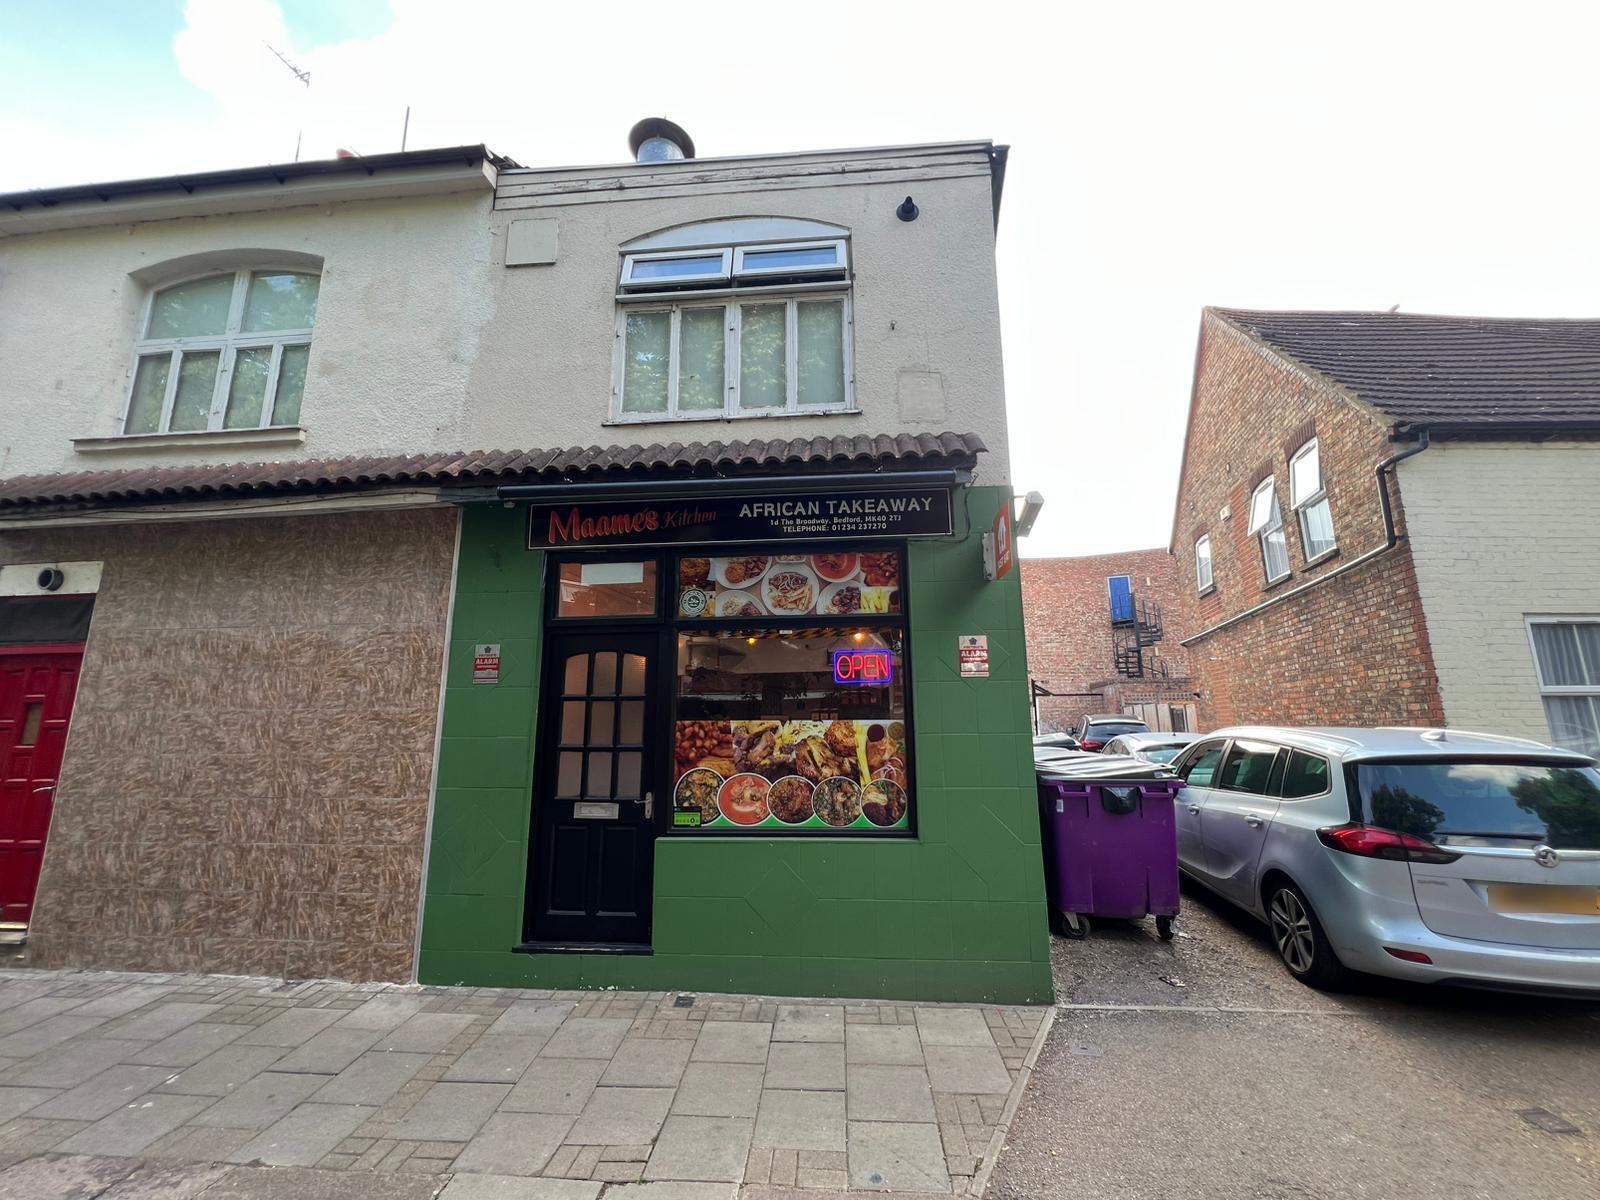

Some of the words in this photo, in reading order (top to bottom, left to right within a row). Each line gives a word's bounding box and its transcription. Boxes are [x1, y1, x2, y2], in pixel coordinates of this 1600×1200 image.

[662, 505, 718, 528] Kitchen
[739, 501, 820, 518] AFRICAN
[826, 497, 932, 514] TAKEAWAY
[865, 514, 887, 522] MK40
[783, 524, 830, 533] TELEPHONE:
[831, 523, 856, 531] 01234
[858, 522, 887, 530] 237270
[837, 654, 888, 679] OPEN
